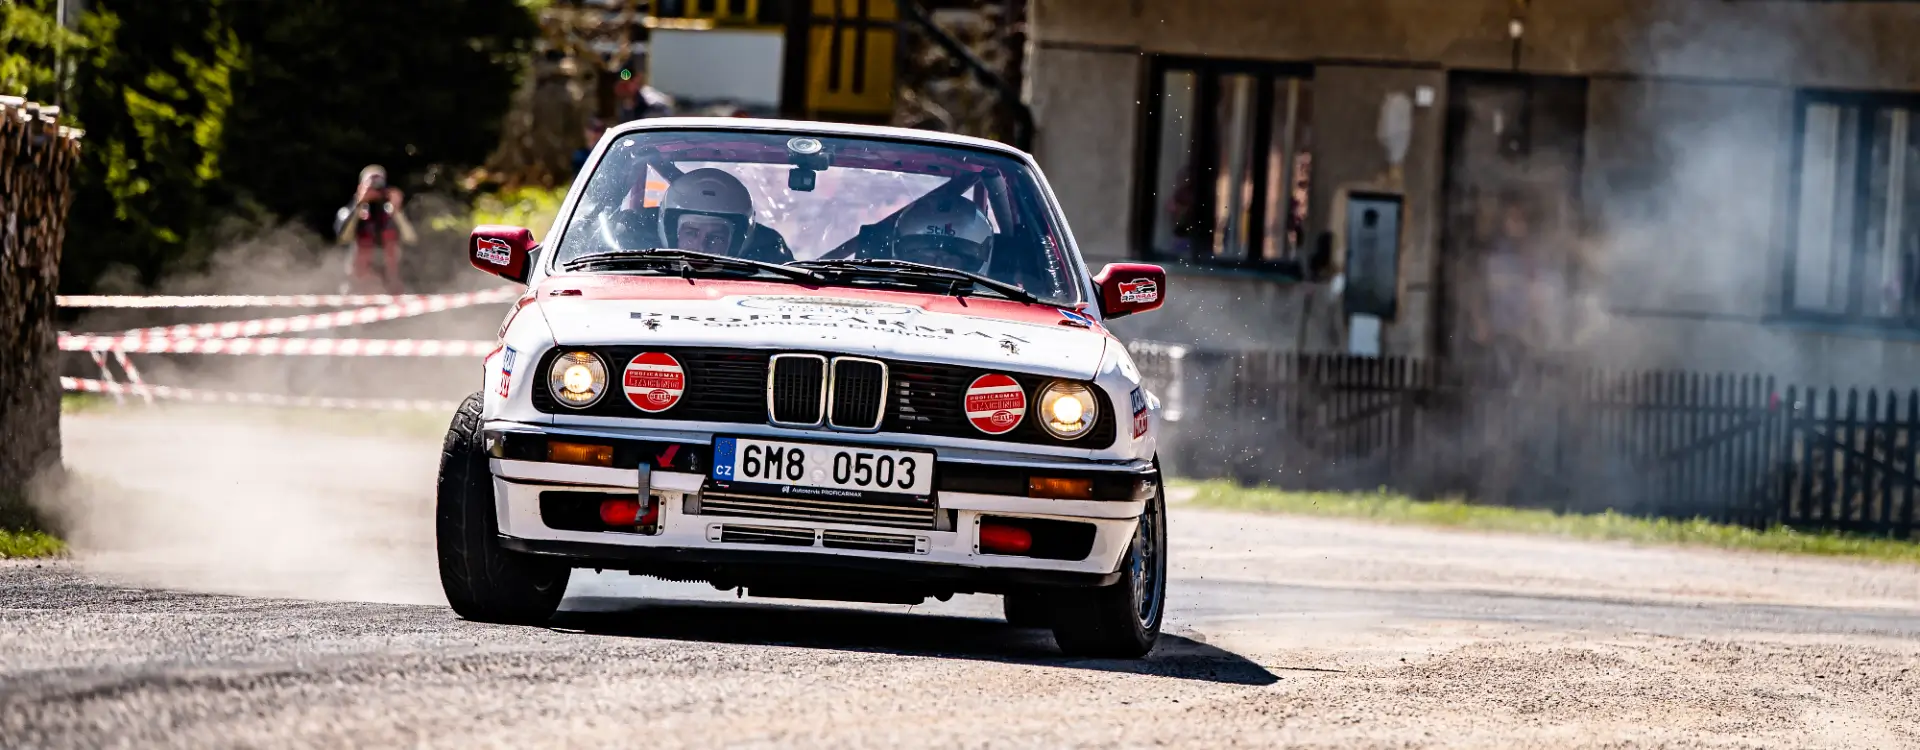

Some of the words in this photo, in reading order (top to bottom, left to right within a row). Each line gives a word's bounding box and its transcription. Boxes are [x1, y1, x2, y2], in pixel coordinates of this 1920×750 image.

[715, 465, 731, 476] CZ
[742, 444, 805, 481] 6M8
[832, 451, 917, 490] 0503
[791, 486, 821, 496] Autoservis
[821, 489, 863, 498] PROFICARMAX
